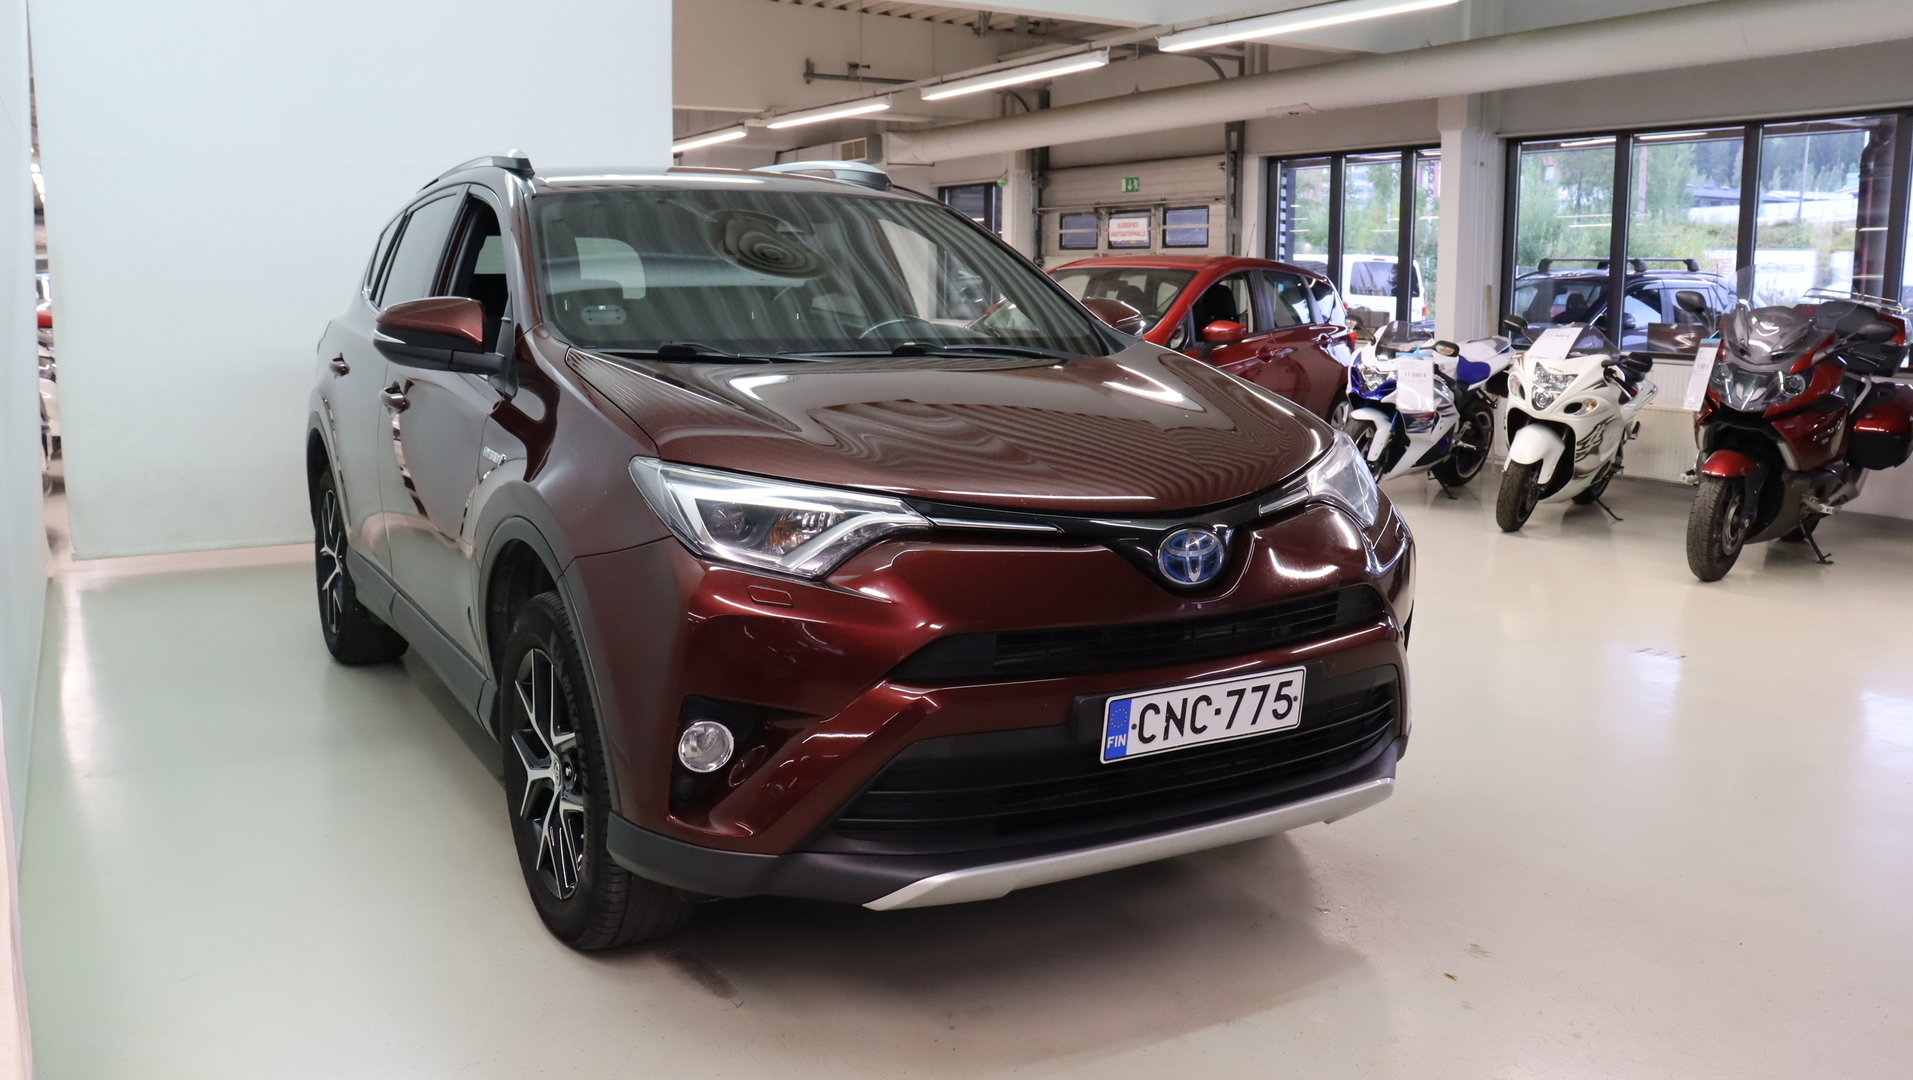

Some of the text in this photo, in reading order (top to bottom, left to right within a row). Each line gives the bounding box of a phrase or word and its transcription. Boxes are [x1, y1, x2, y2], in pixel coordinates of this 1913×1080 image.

[561, 674, 591, 788] MICHELIN
[1106, 734, 1127, 750] FIN
[1137, 679, 1294, 745] CNC-775
